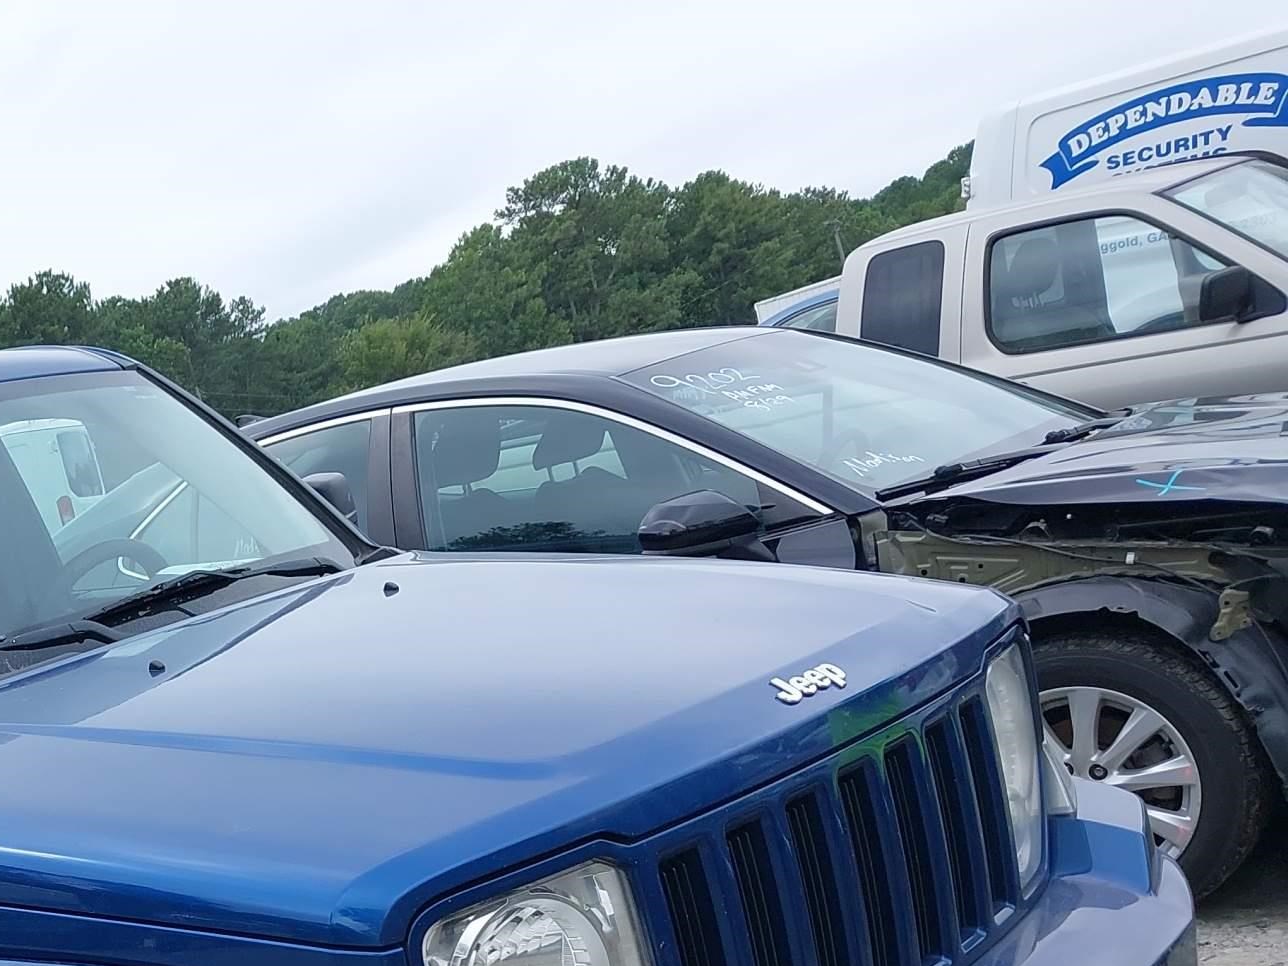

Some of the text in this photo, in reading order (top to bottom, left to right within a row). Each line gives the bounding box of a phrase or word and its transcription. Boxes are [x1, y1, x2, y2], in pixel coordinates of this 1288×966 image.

[1068, 82, 1279, 157] DEPENDABLE
[1106, 124, 1233, 170] SECURITY
[650, 367, 761, 395] 9202
[769, 663, 847, 706] Jeep
